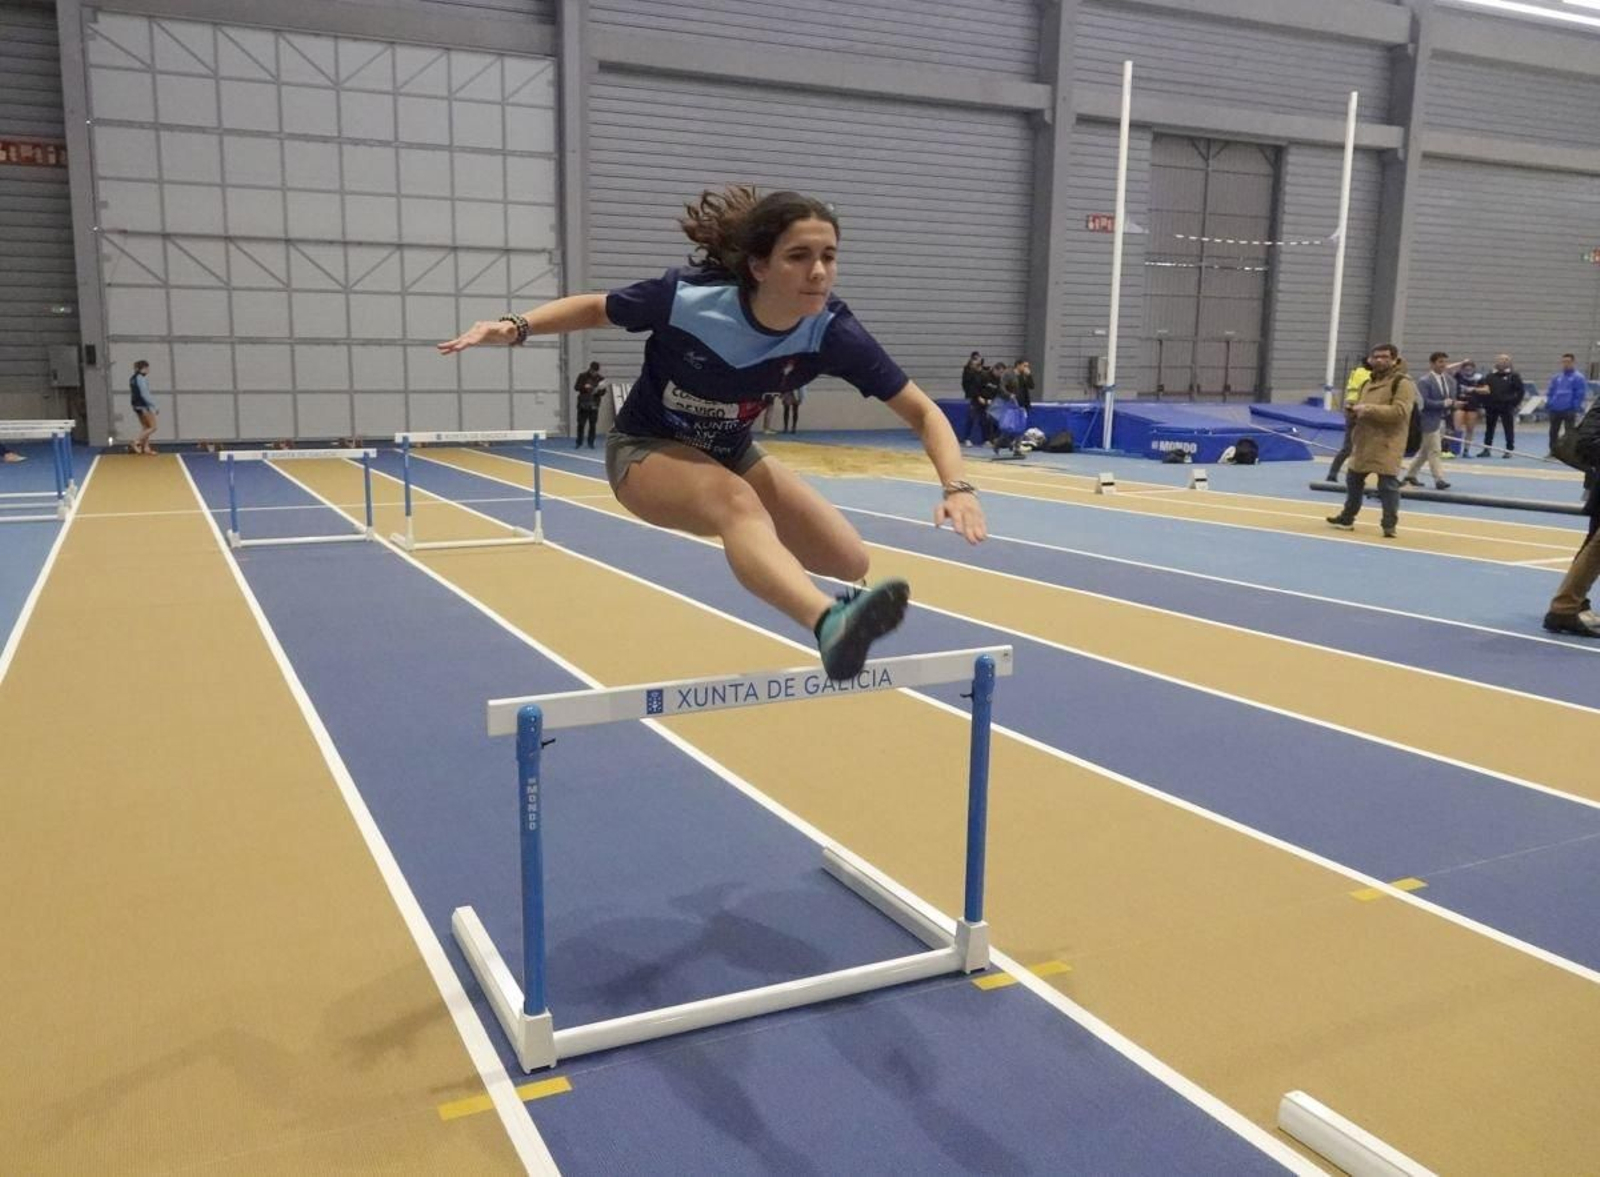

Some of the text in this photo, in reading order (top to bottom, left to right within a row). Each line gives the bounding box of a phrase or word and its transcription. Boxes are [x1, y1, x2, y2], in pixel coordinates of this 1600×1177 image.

[677, 682, 759, 710] XUNTA
[767, 677, 796, 700] DE
[527, 785, 538, 831] MONDO
